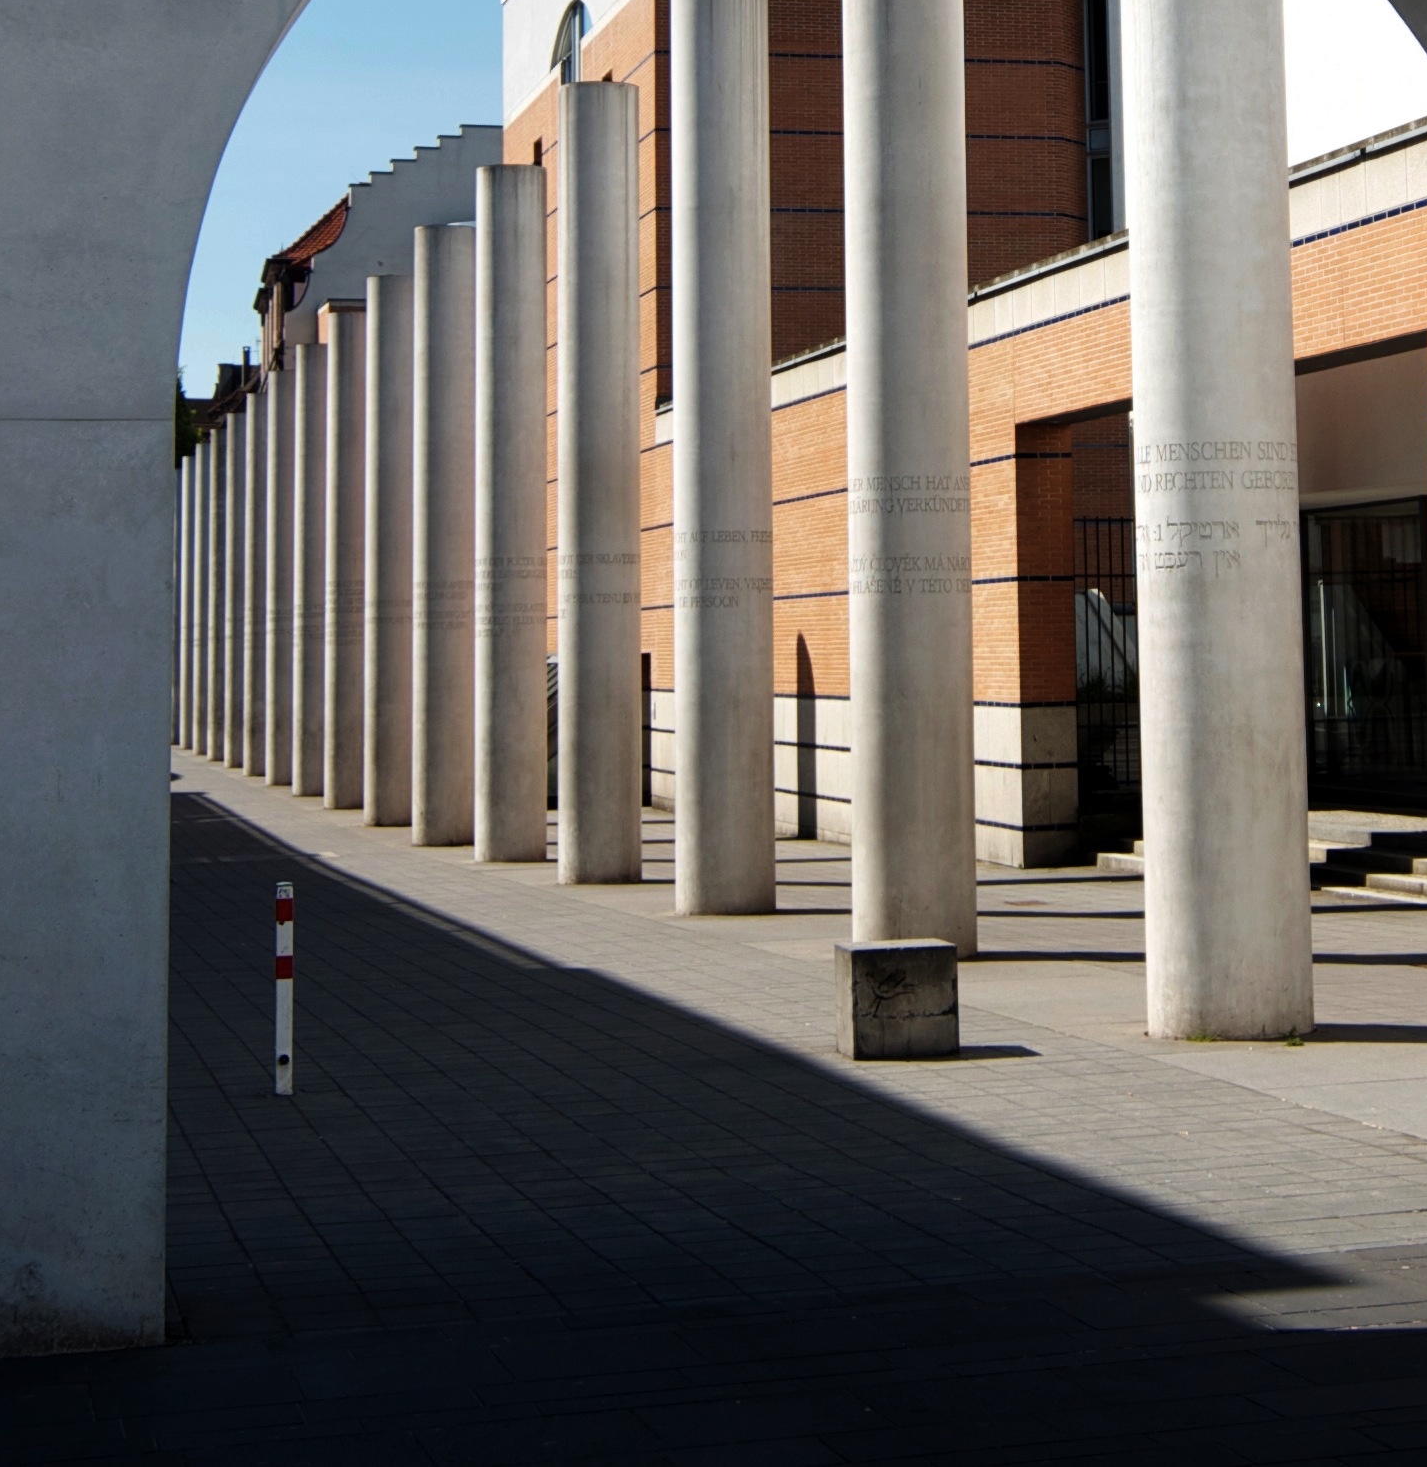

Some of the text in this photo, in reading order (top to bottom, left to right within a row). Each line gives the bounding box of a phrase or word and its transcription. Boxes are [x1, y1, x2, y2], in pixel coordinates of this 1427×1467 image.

[1155, 441, 1252, 462] MENSCHEN
[1258, 441, 1287, 461] SIND
[867, 475, 922, 492] MENSCH
[925, 475, 951, 491] HAT
[1155, 470, 1235, 491] RECHTEN
